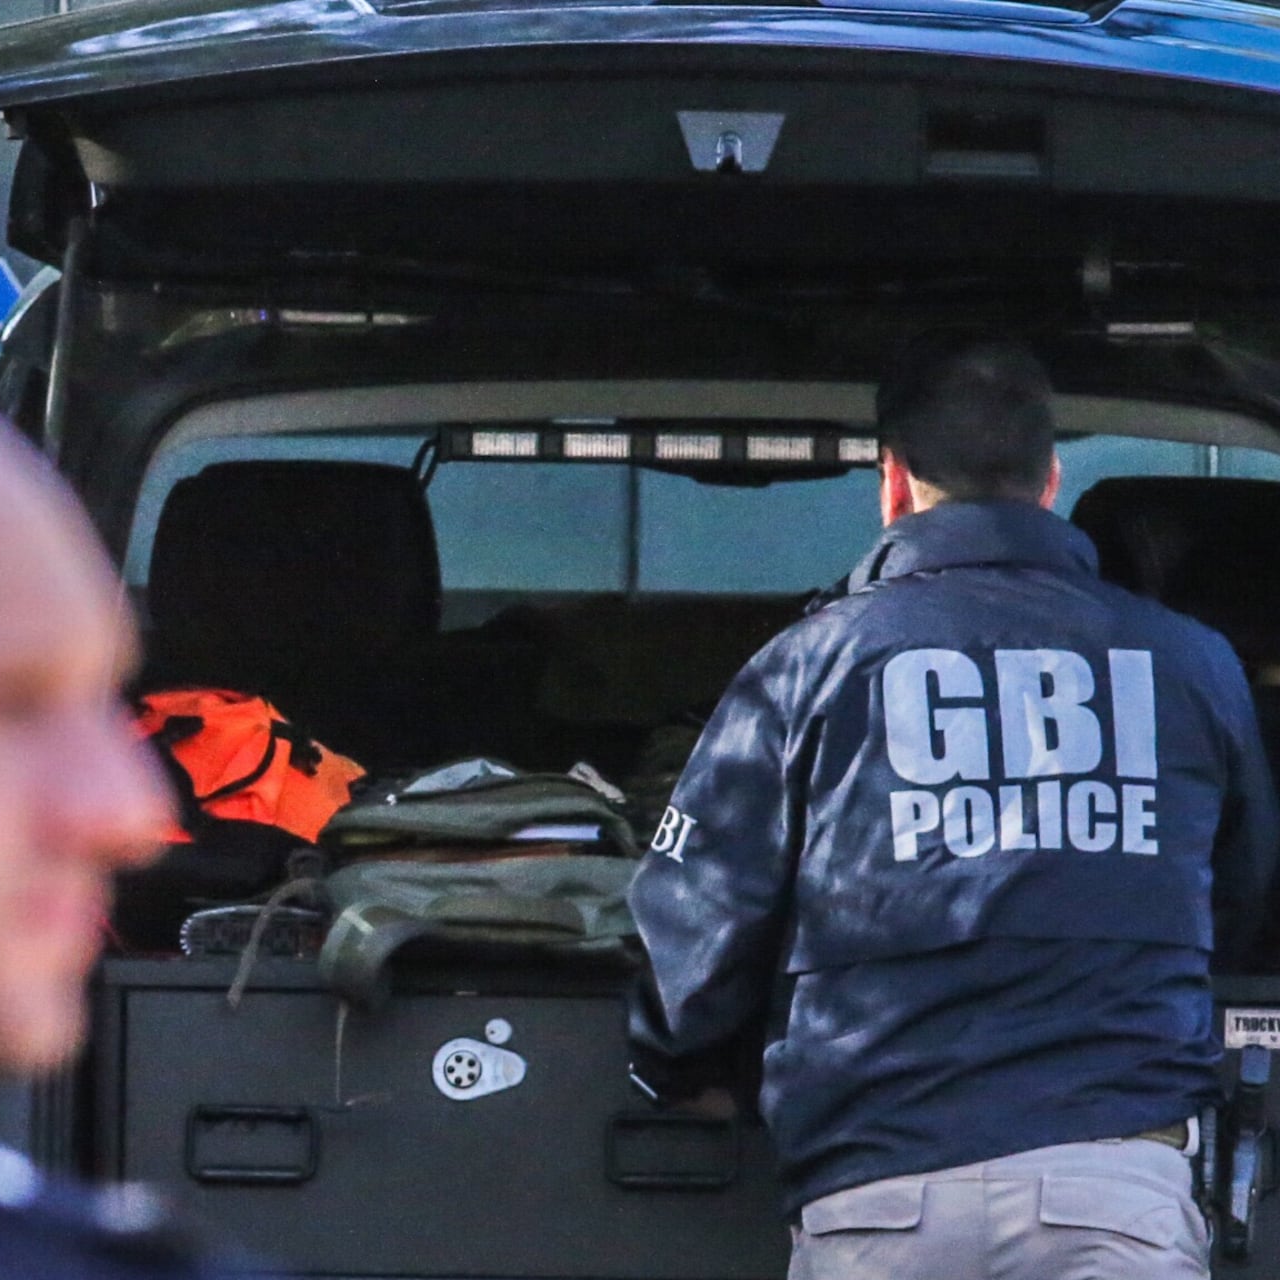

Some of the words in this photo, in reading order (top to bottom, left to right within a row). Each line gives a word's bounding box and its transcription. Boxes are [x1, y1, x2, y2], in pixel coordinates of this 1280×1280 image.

[882, 647, 1158, 786] GBI
[650, 805, 698, 863] BI
[888, 779, 1159, 863] POLICE
